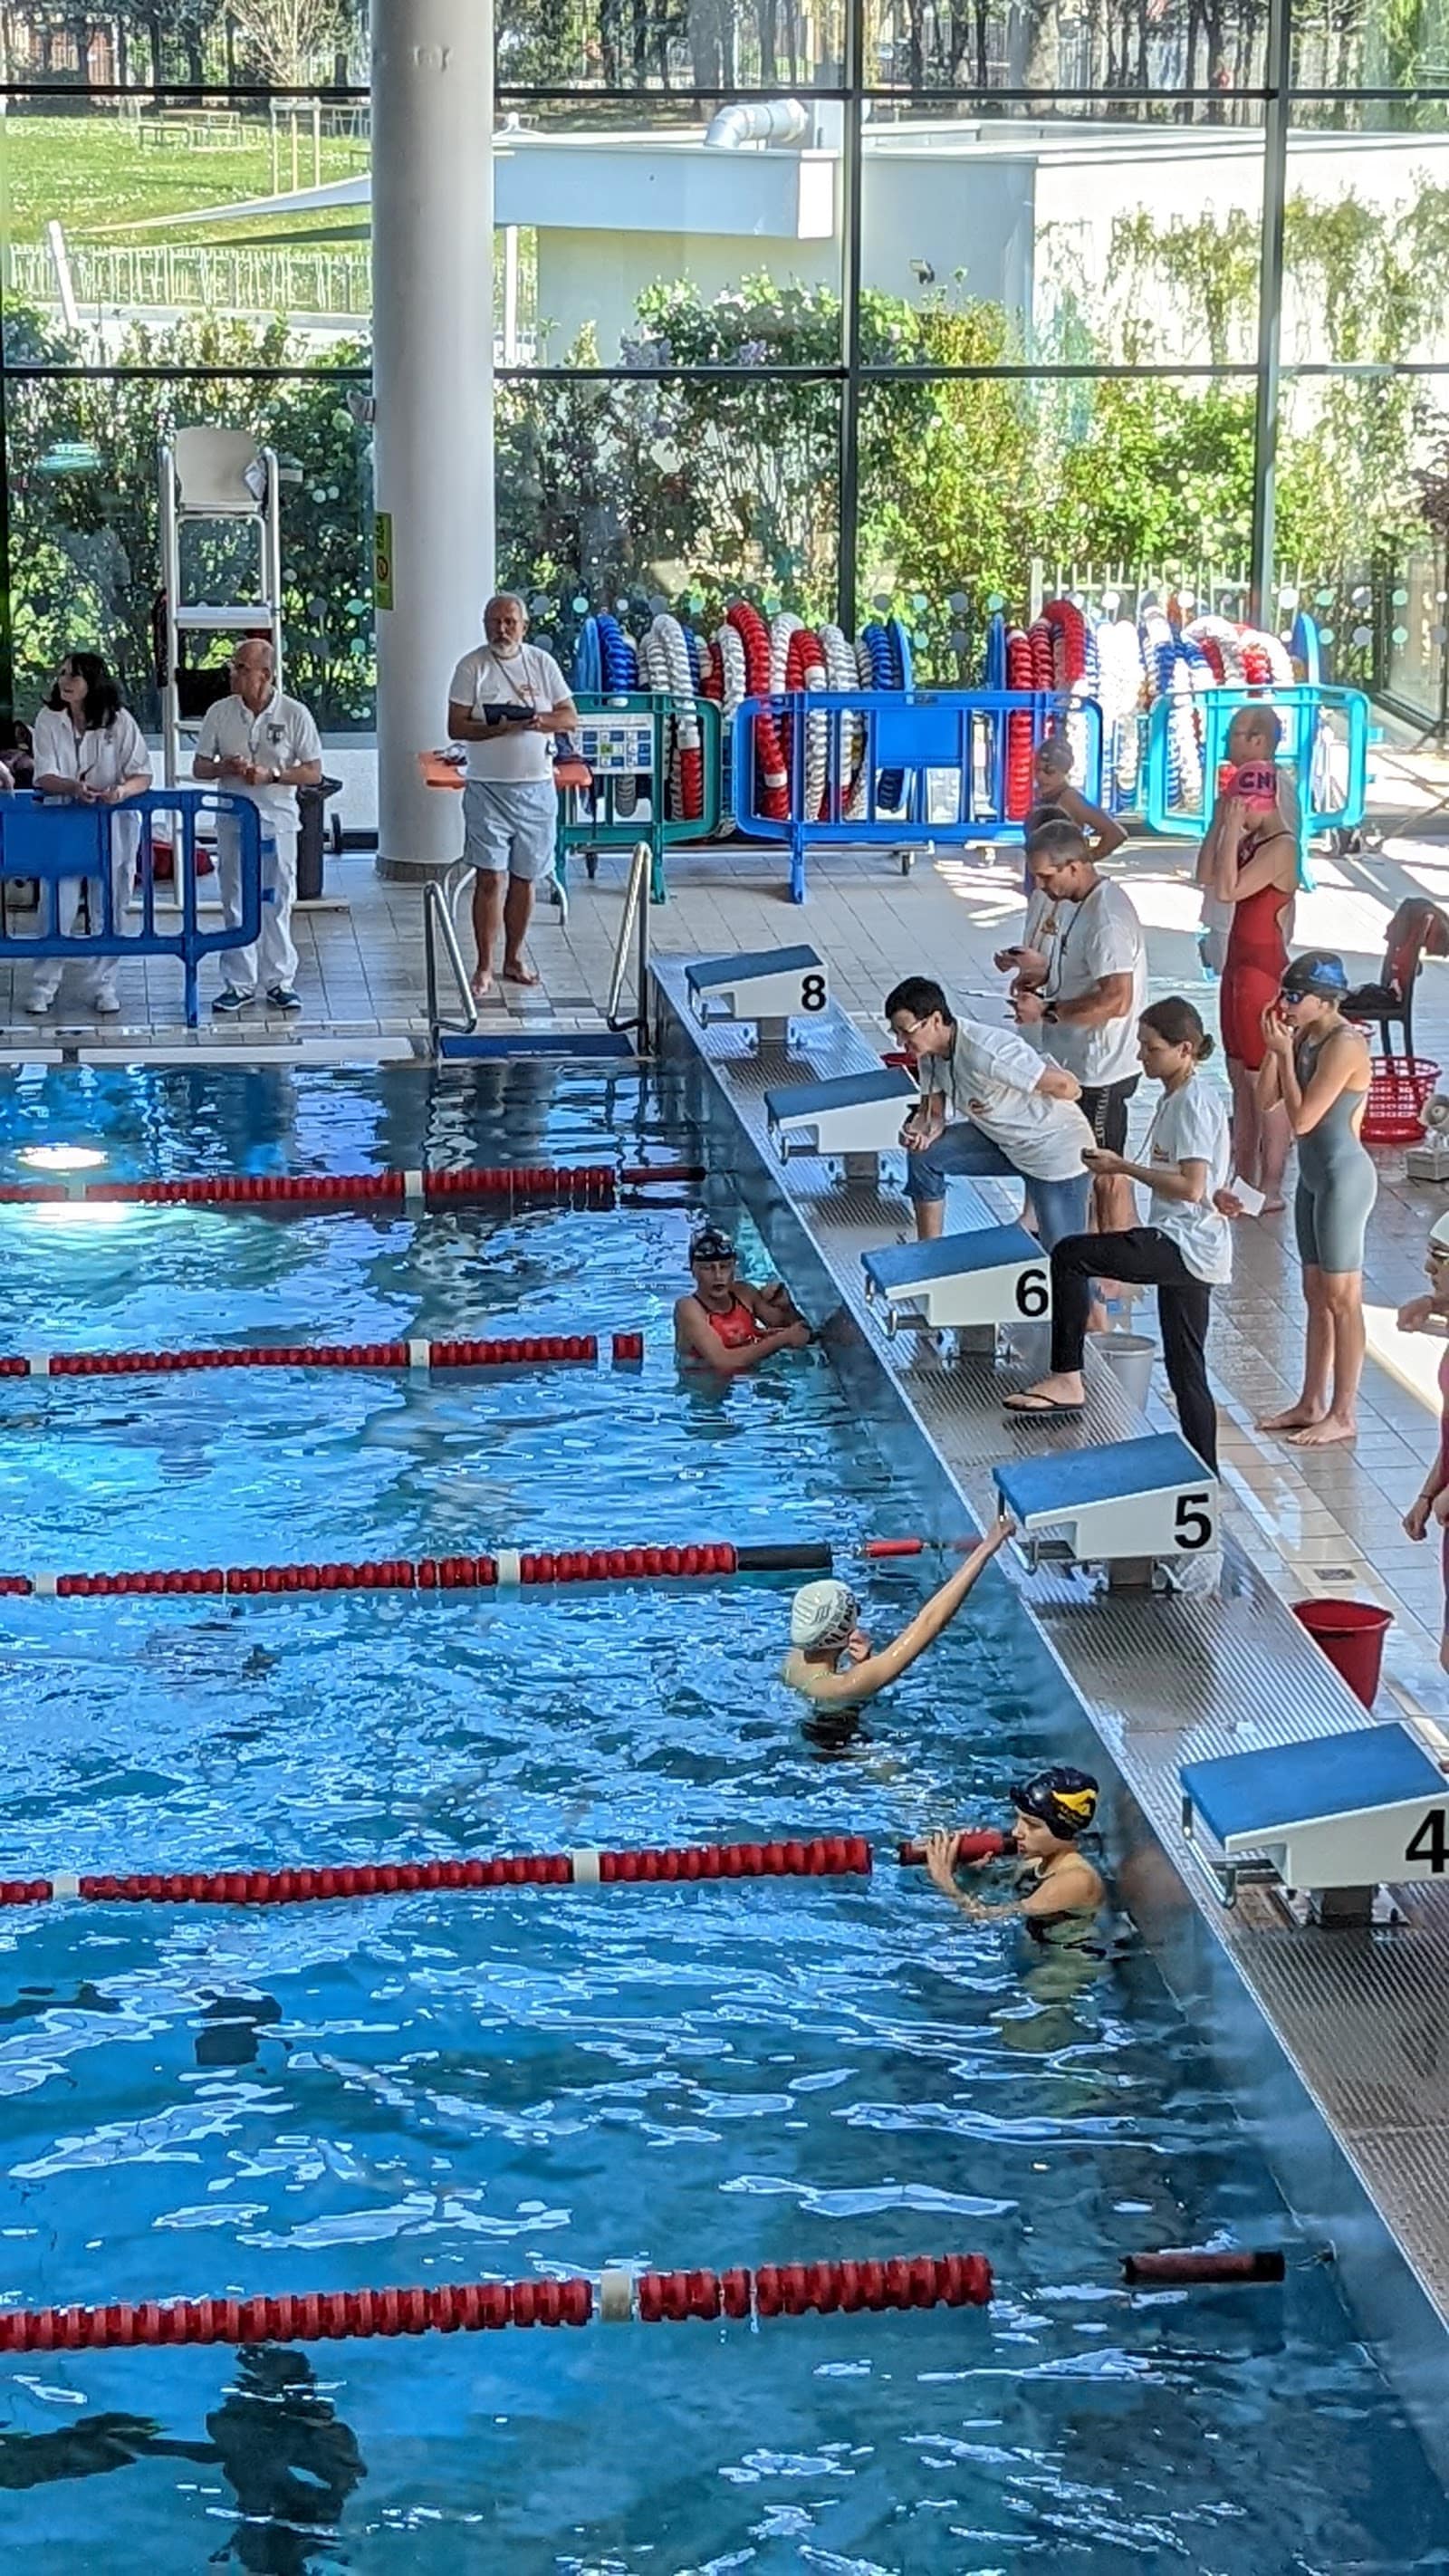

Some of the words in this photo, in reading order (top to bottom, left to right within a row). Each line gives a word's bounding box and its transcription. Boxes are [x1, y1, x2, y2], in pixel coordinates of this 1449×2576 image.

[801, 974, 826, 1012] 8
[1015, 1268, 1049, 1317] 6
[1174, 1493, 1212, 1549] 5
[1405, 1809, 1449, 1873] 4
